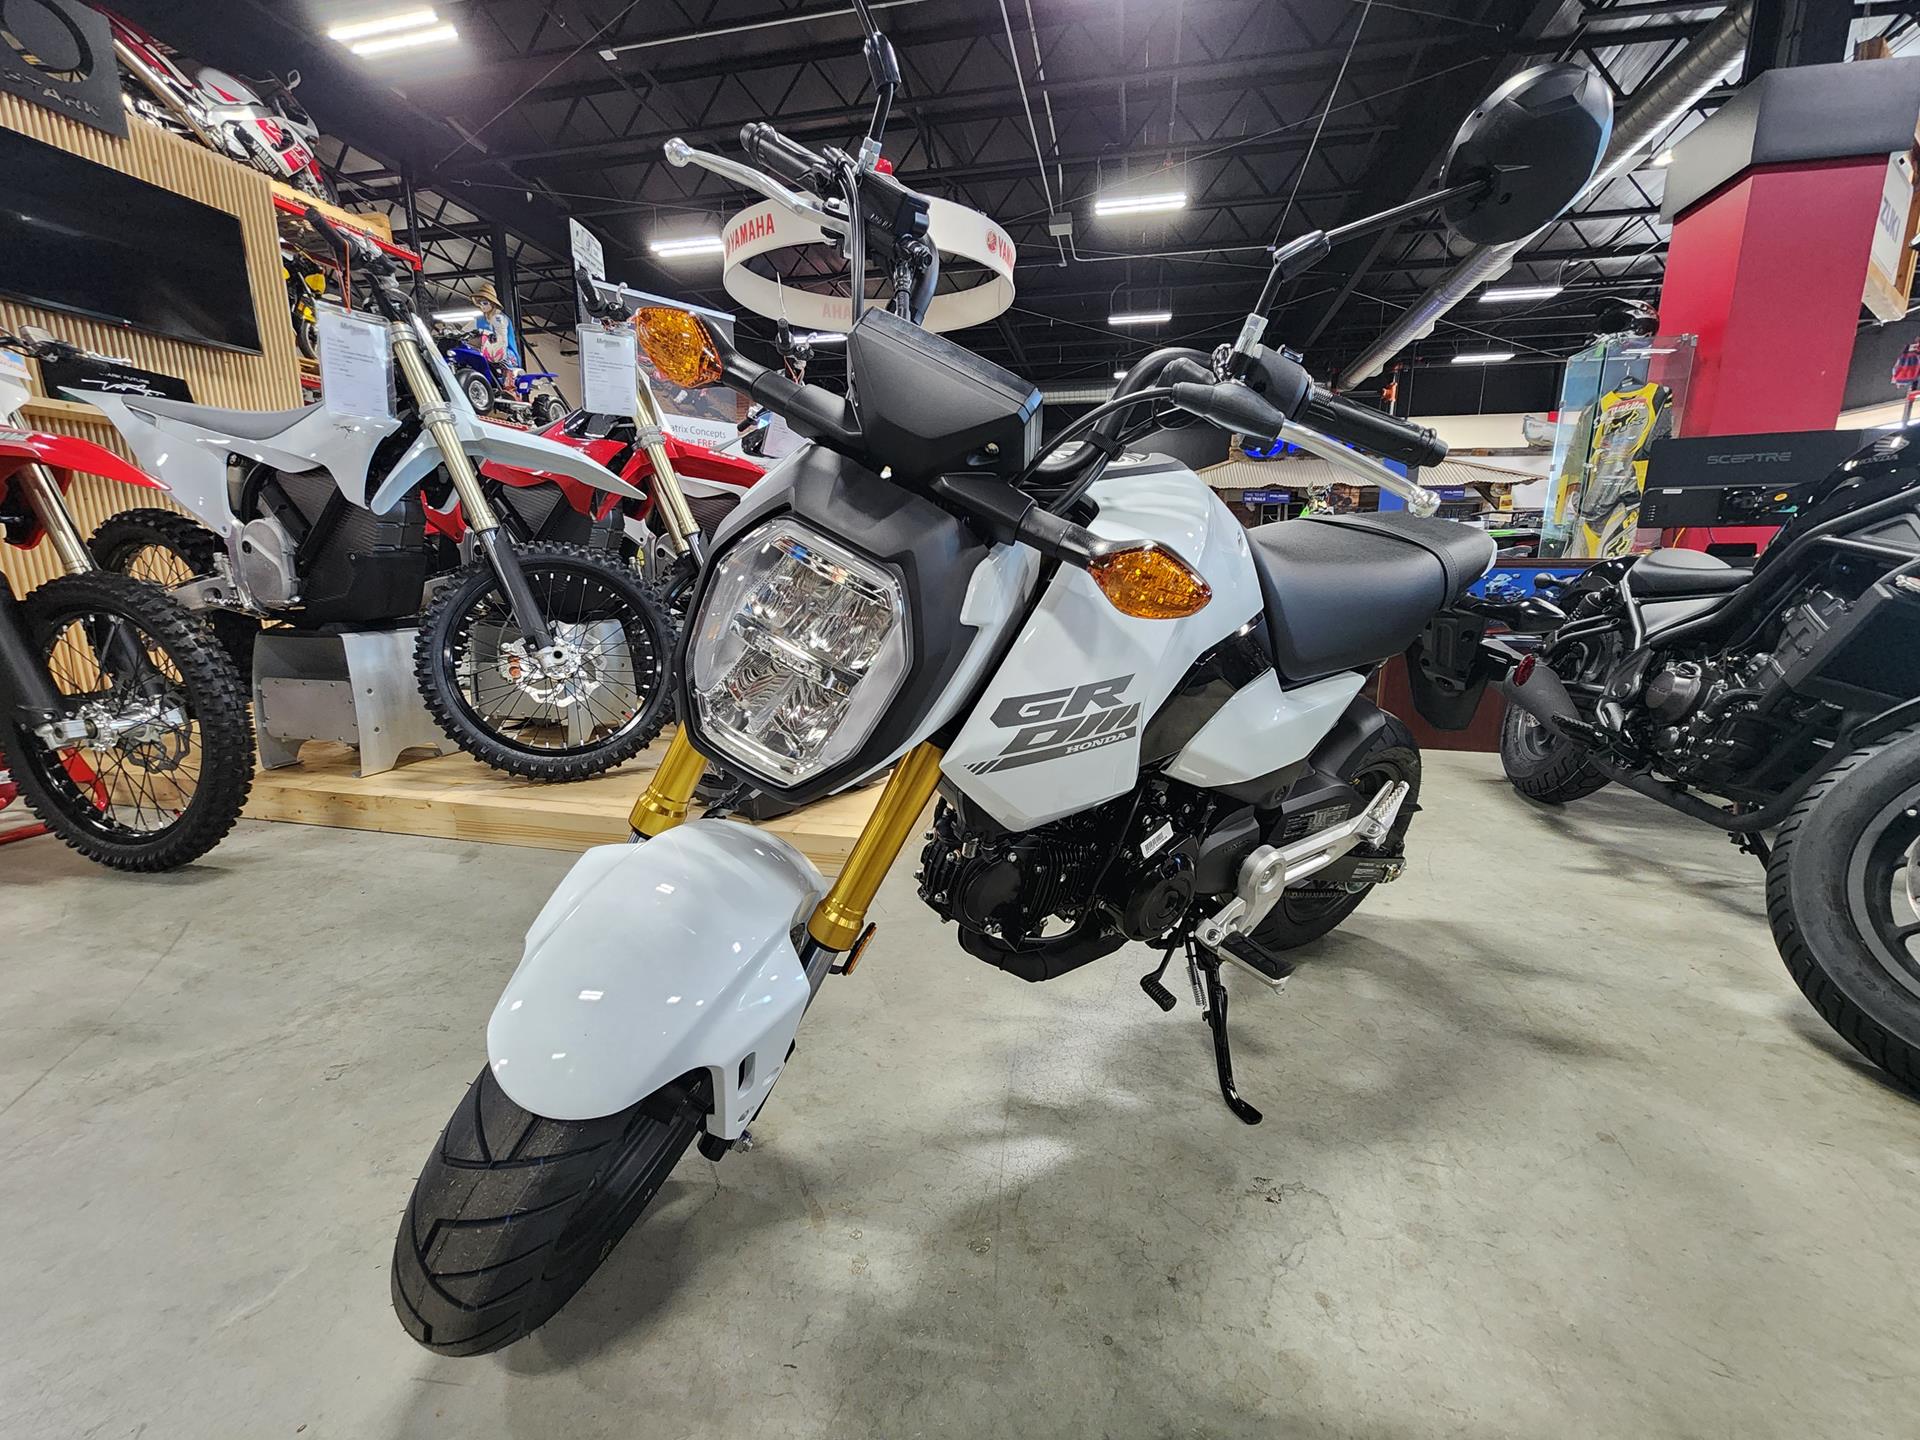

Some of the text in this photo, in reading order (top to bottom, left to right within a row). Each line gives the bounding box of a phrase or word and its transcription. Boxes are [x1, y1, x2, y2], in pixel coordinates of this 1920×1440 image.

[252, 140, 280, 175] YAMAHA
[730, 213, 775, 251] YAMAHA
[690, 425, 726, 439] Concepts
[1707, 452, 1792, 465] SCEPTRE
[990, 673, 1136, 728] GR
[1065, 732, 1128, 754] HONDA
